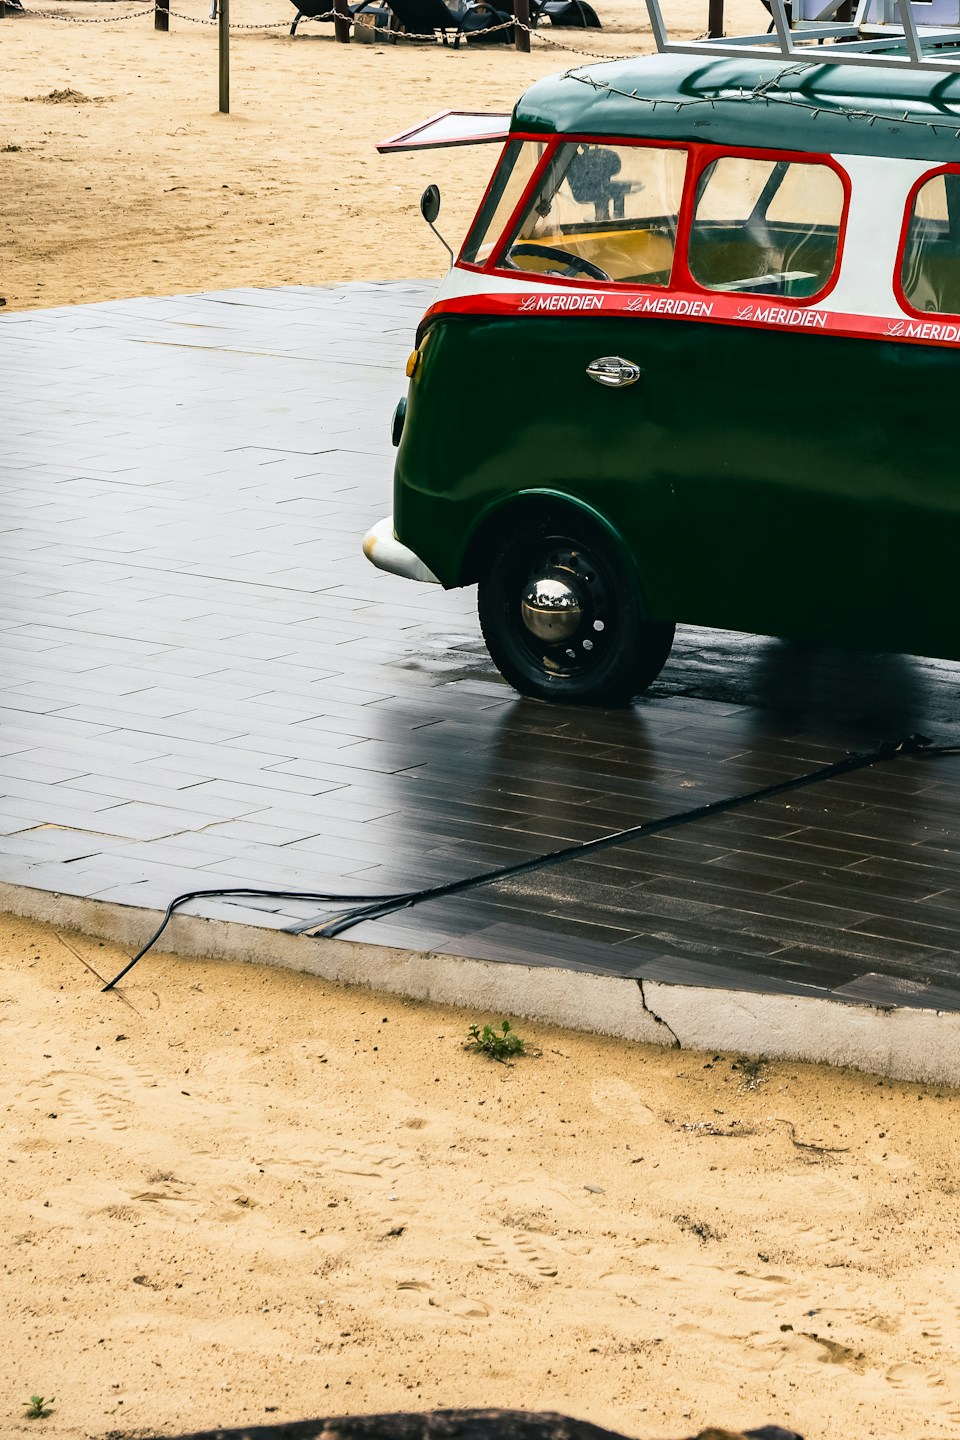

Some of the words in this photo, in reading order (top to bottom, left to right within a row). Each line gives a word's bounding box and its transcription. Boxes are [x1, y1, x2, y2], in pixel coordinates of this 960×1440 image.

[518, 295, 538, 311] Le
[536, 295, 603, 310] MERIDIEN
[622, 296, 642, 312] Le
[641, 298, 713, 317] MERIDIEN
[733, 305, 753, 321] Le
[753, 307, 827, 328] MERIDIEN
[883, 320, 904, 337] Le
